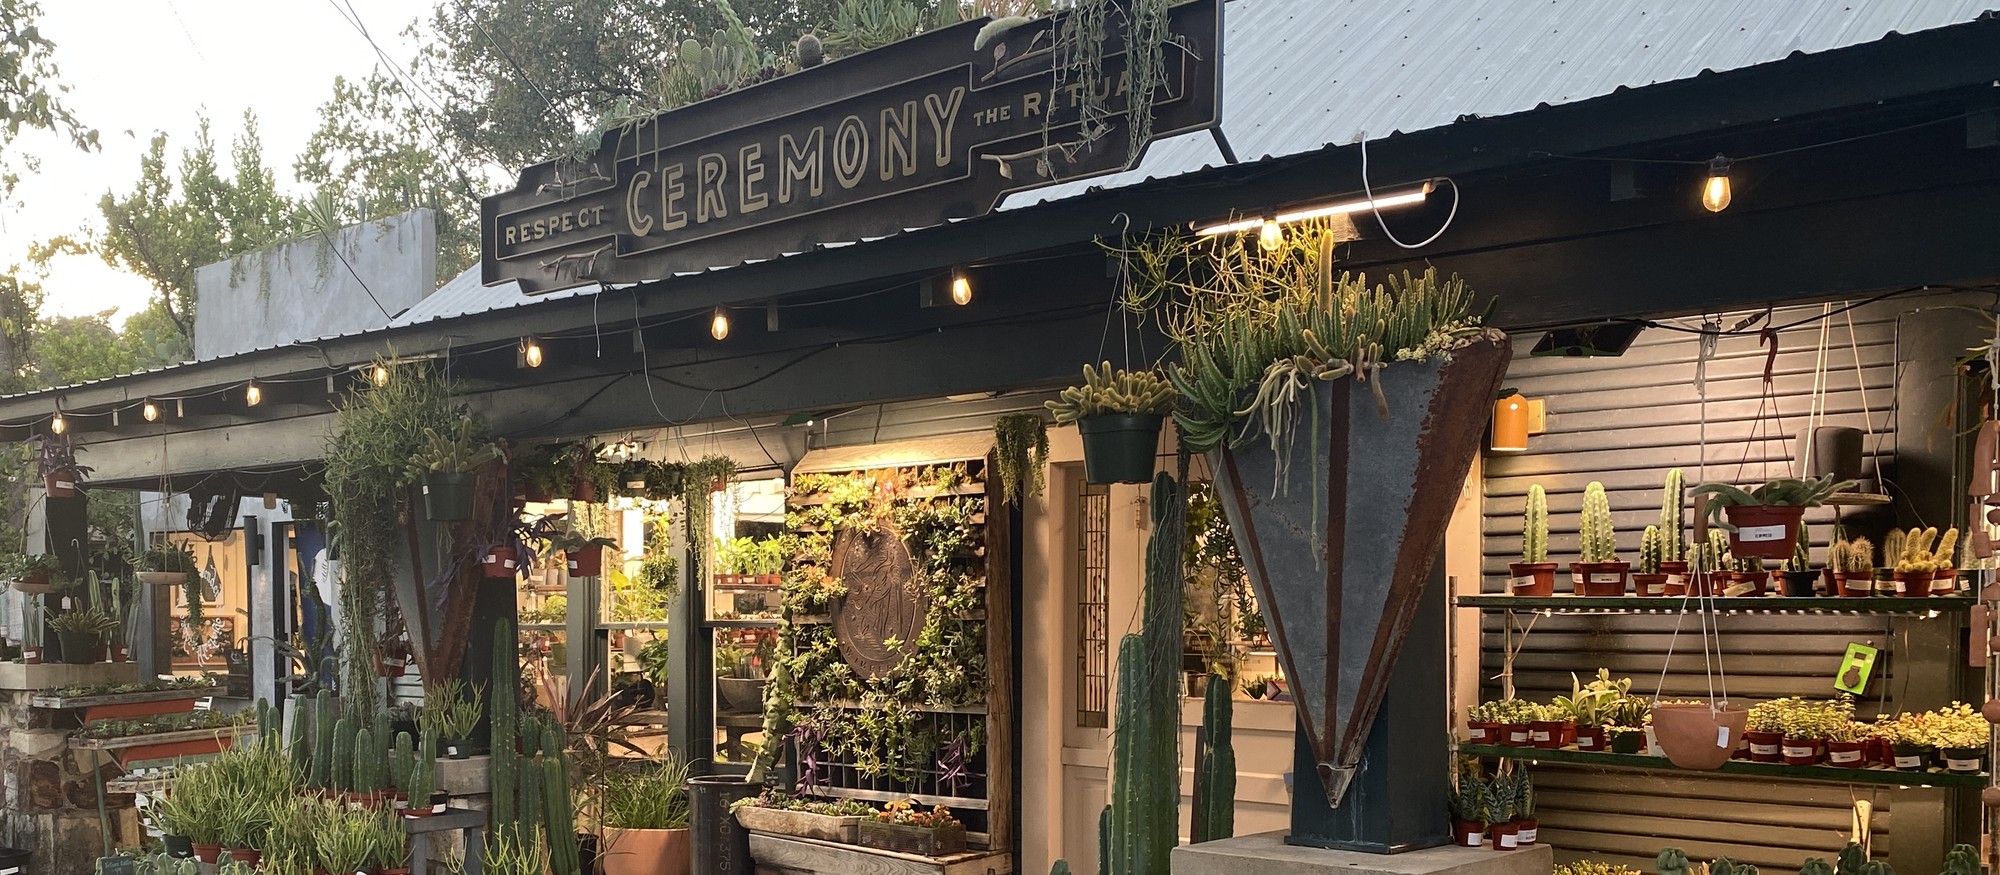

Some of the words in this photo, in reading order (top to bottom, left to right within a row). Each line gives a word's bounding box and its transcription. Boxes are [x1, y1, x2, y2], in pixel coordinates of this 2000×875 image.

[505, 203, 604, 246] RESPECT
[625, 85, 967, 238] CEREMONY
[973, 105, 1011, 127] THE
